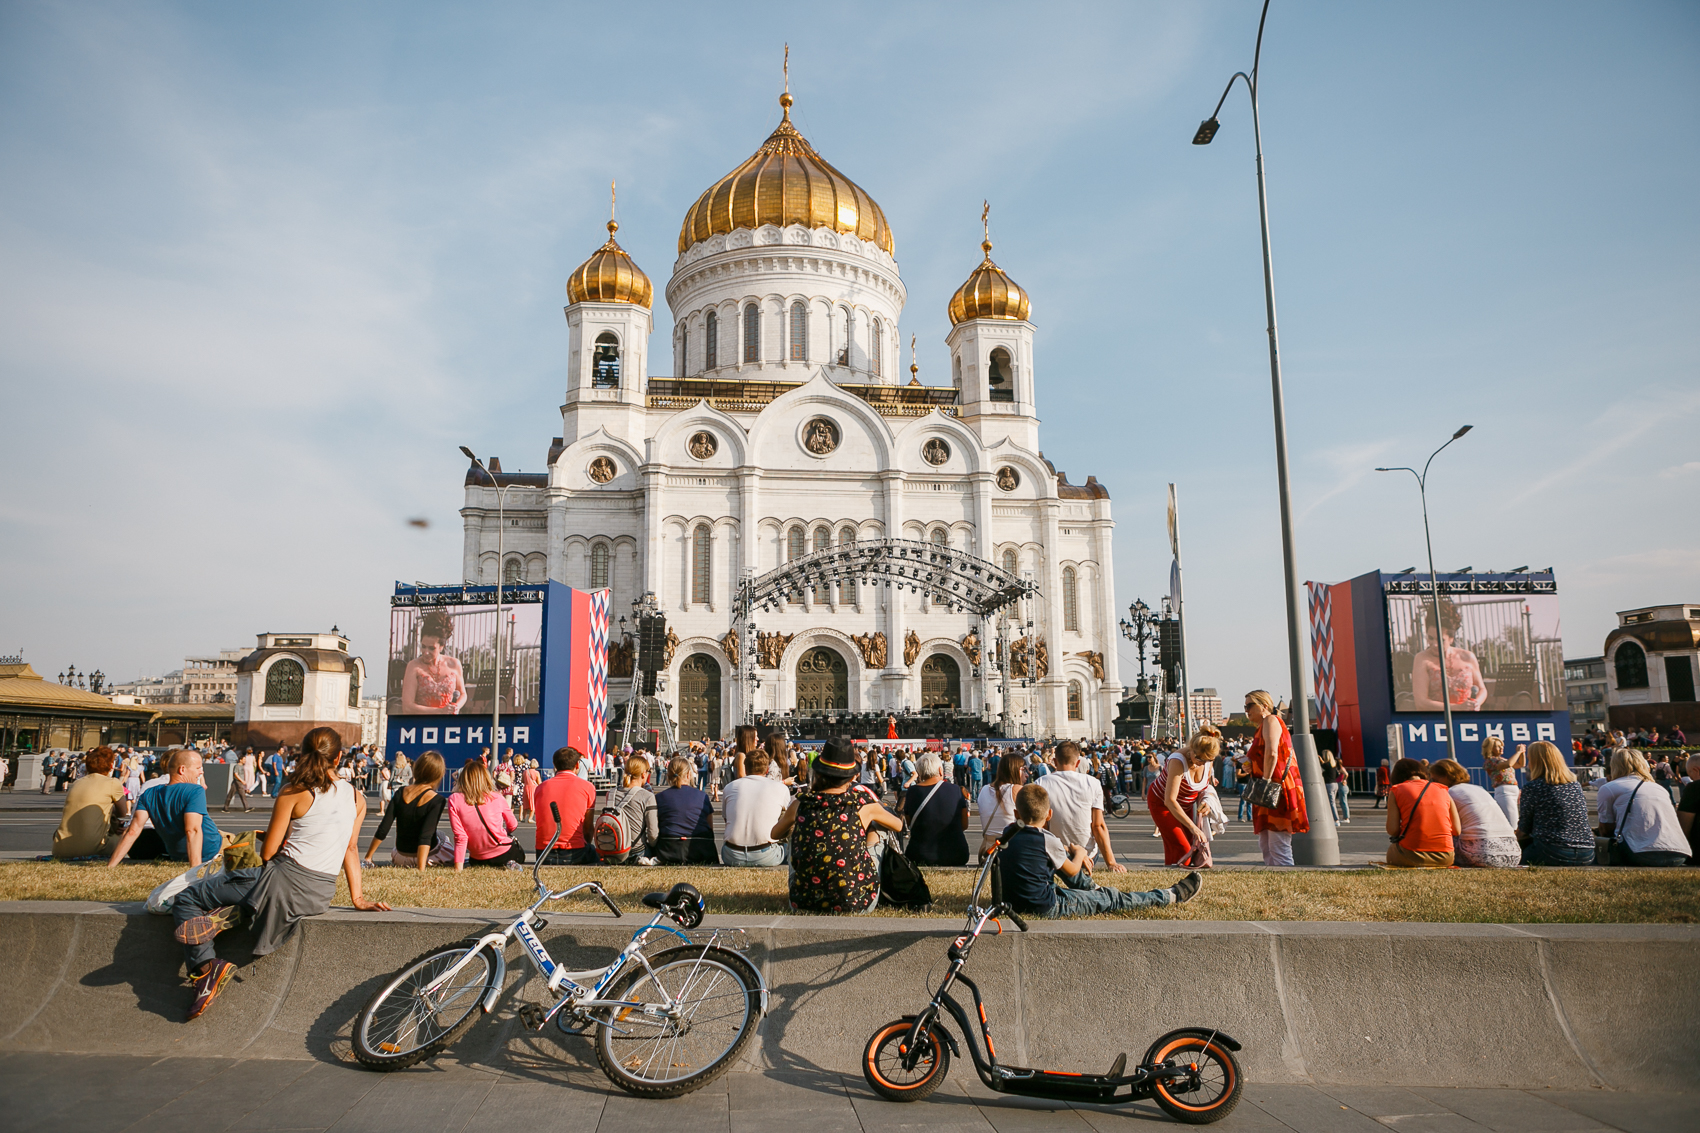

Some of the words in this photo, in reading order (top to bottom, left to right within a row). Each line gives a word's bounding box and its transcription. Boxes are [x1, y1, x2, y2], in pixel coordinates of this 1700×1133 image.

[399, 726, 530, 744] МОСКВА
[1408, 722, 1556, 742] МОСКВА
[518, 924, 549, 963] STELS
